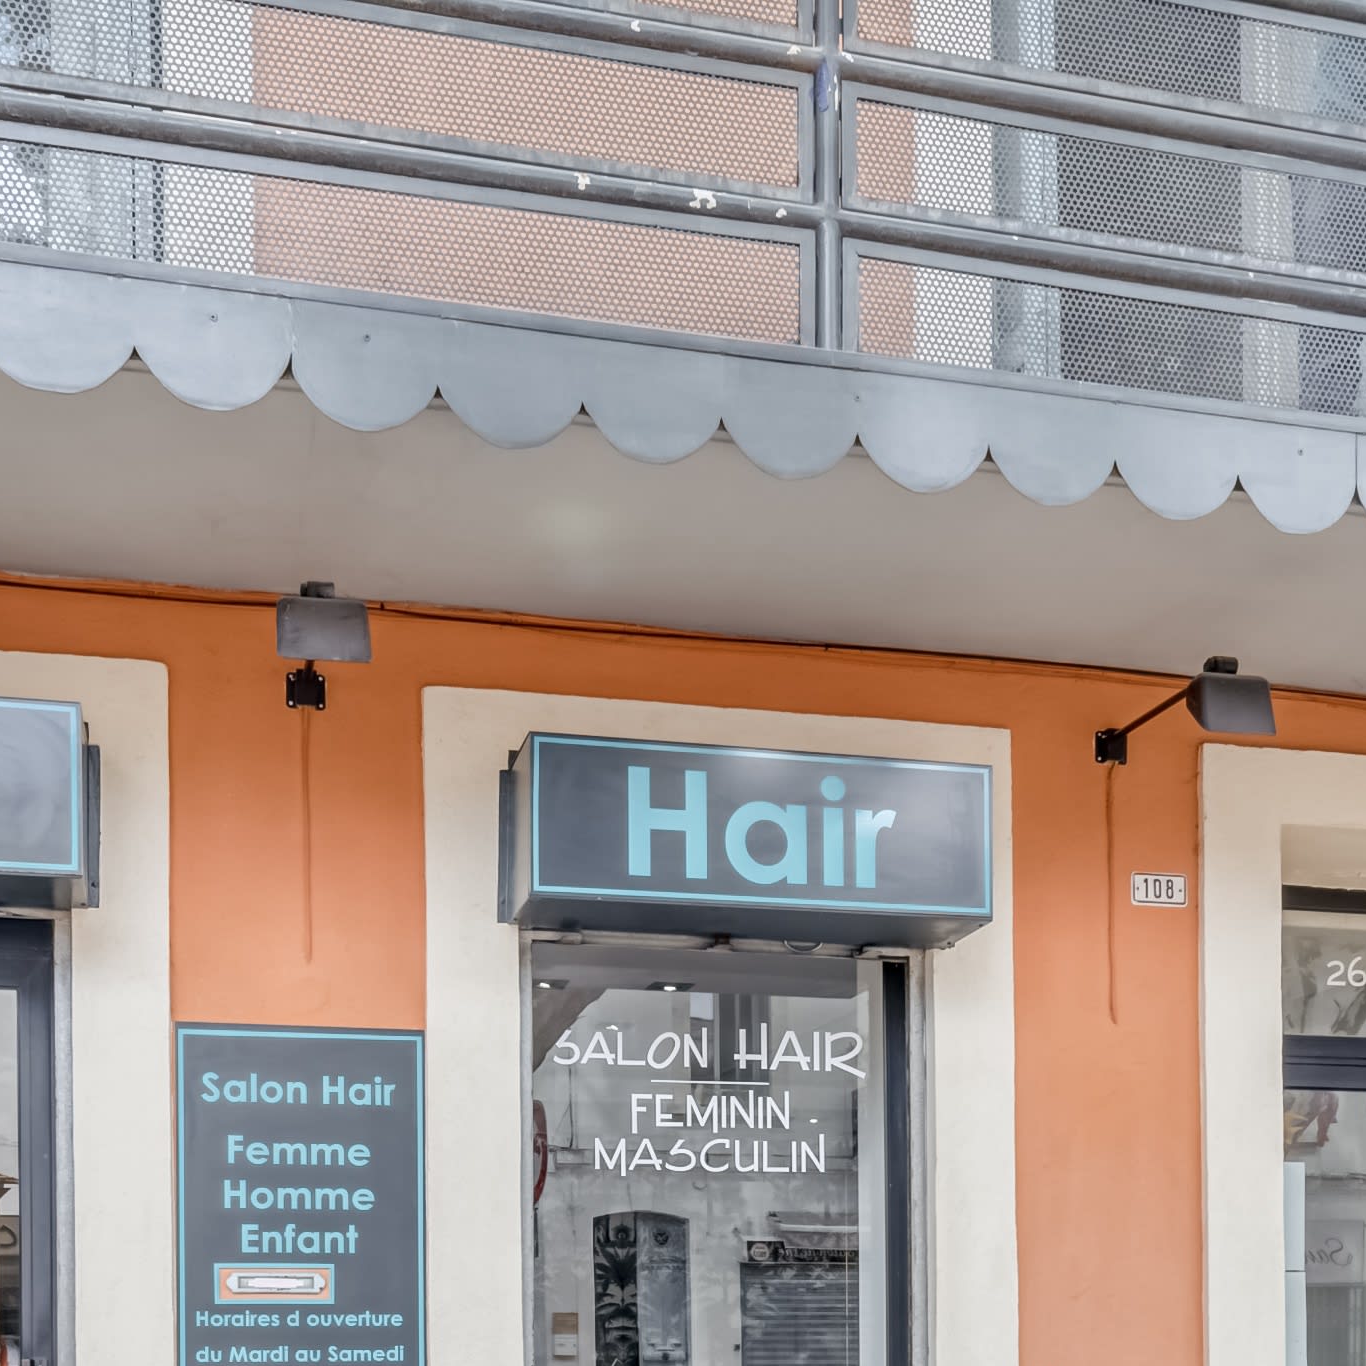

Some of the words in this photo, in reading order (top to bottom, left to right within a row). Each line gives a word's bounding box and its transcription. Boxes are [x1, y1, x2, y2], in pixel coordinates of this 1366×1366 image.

[627, 765, 897, 889] Hair
[1143, 878, 1175, 899] 108
[553, 1027, 708, 1069] SALON
[733, 1022, 867, 1080] HAIR
[200, 1071, 308, 1105] Salon
[322, 1075, 396, 1106] Hair
[631, 1089, 790, 1134] FEMININ
[227, 1134, 371, 1167] Femme
[594, 1133, 825, 1177] MASCULIN
[223, 1179, 376, 1211] Homme
[241, 1223, 359, 1254] Enfant
[195, 1310, 280, 1328] Horaires
[286, 1310, 300, 1328] d
[307, 1310, 404, 1328] ouverture
[195, 1347, 222, 1363] du
[229, 1346, 289, 1364] Mardi
[295, 1349, 321, 1363] au
[327, 1345, 405, 1363] Samedi
